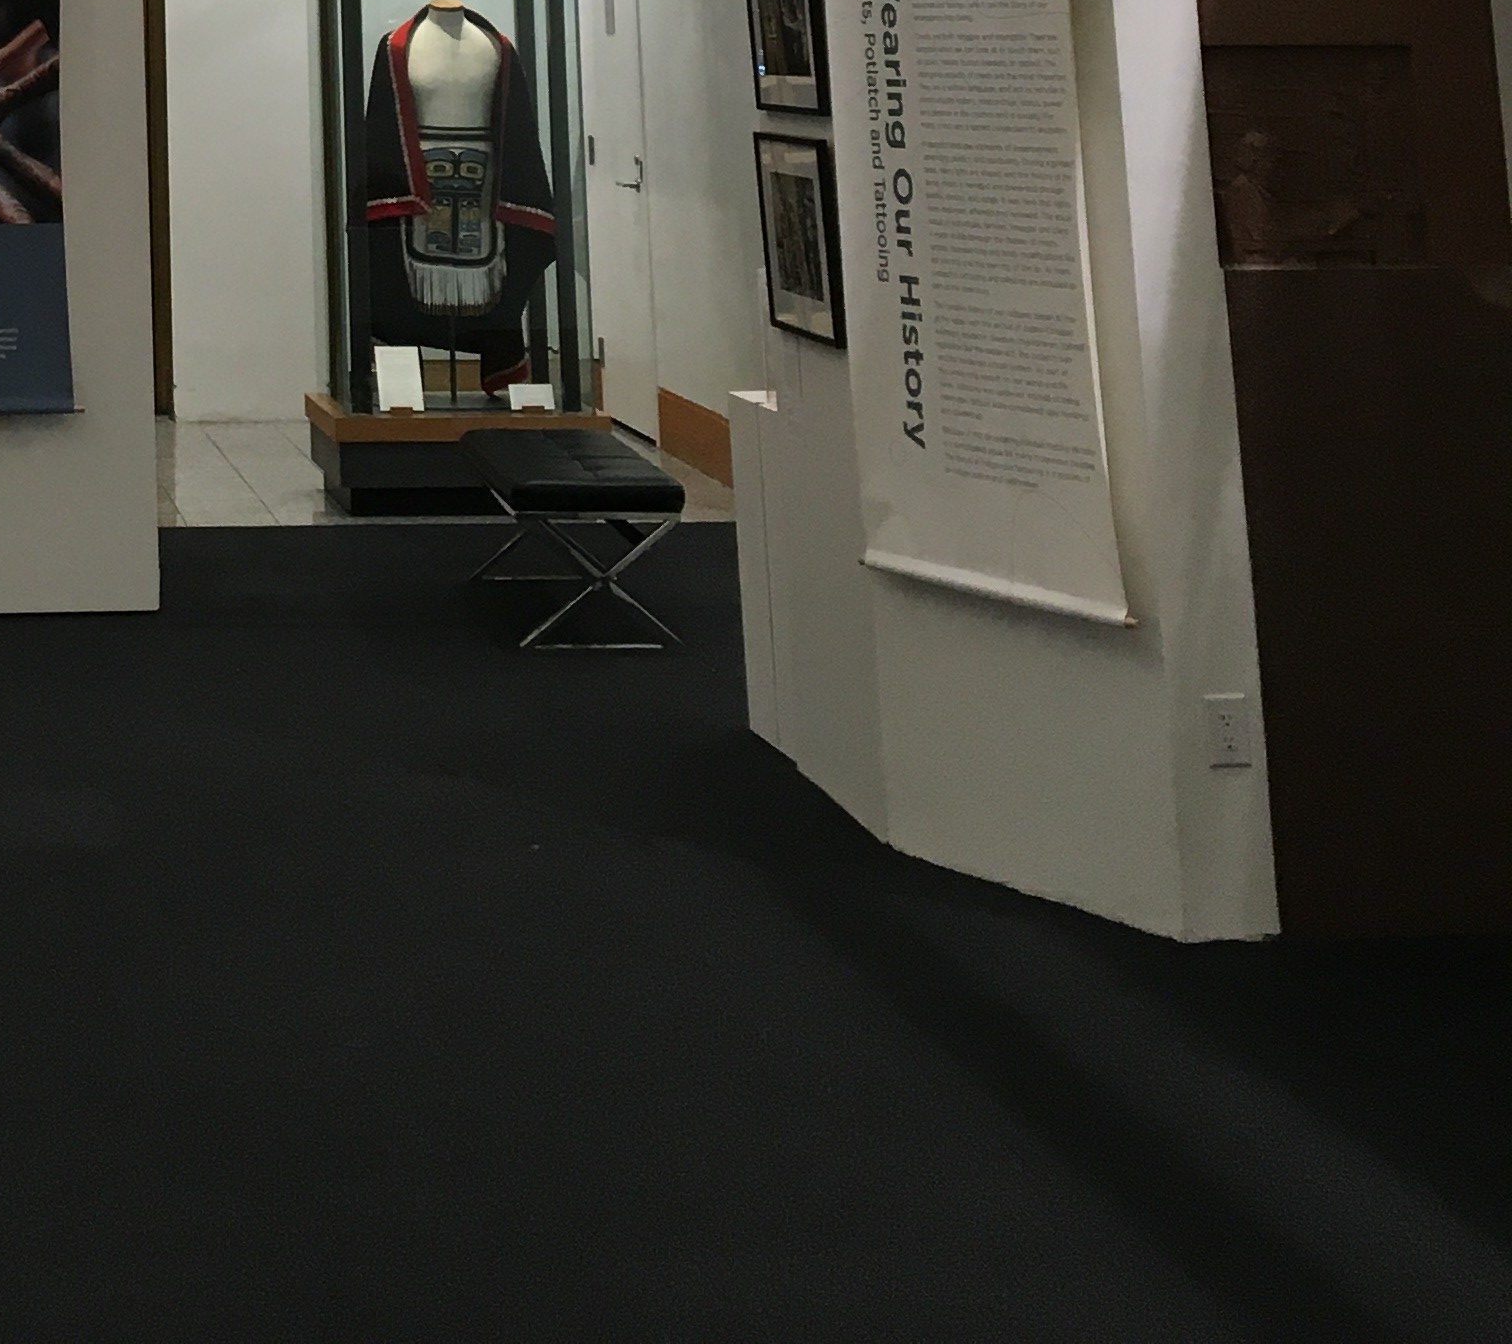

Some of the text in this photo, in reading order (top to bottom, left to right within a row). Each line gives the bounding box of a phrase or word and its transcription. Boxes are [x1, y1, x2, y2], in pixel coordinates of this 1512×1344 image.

[864, 32, 882, 122] Potlatch
[869, 128, 885, 170] and
[874, 177, 890, 283] Tattooing
[893, 168, 914, 258] Our
[899, 274, 926, 450] History
